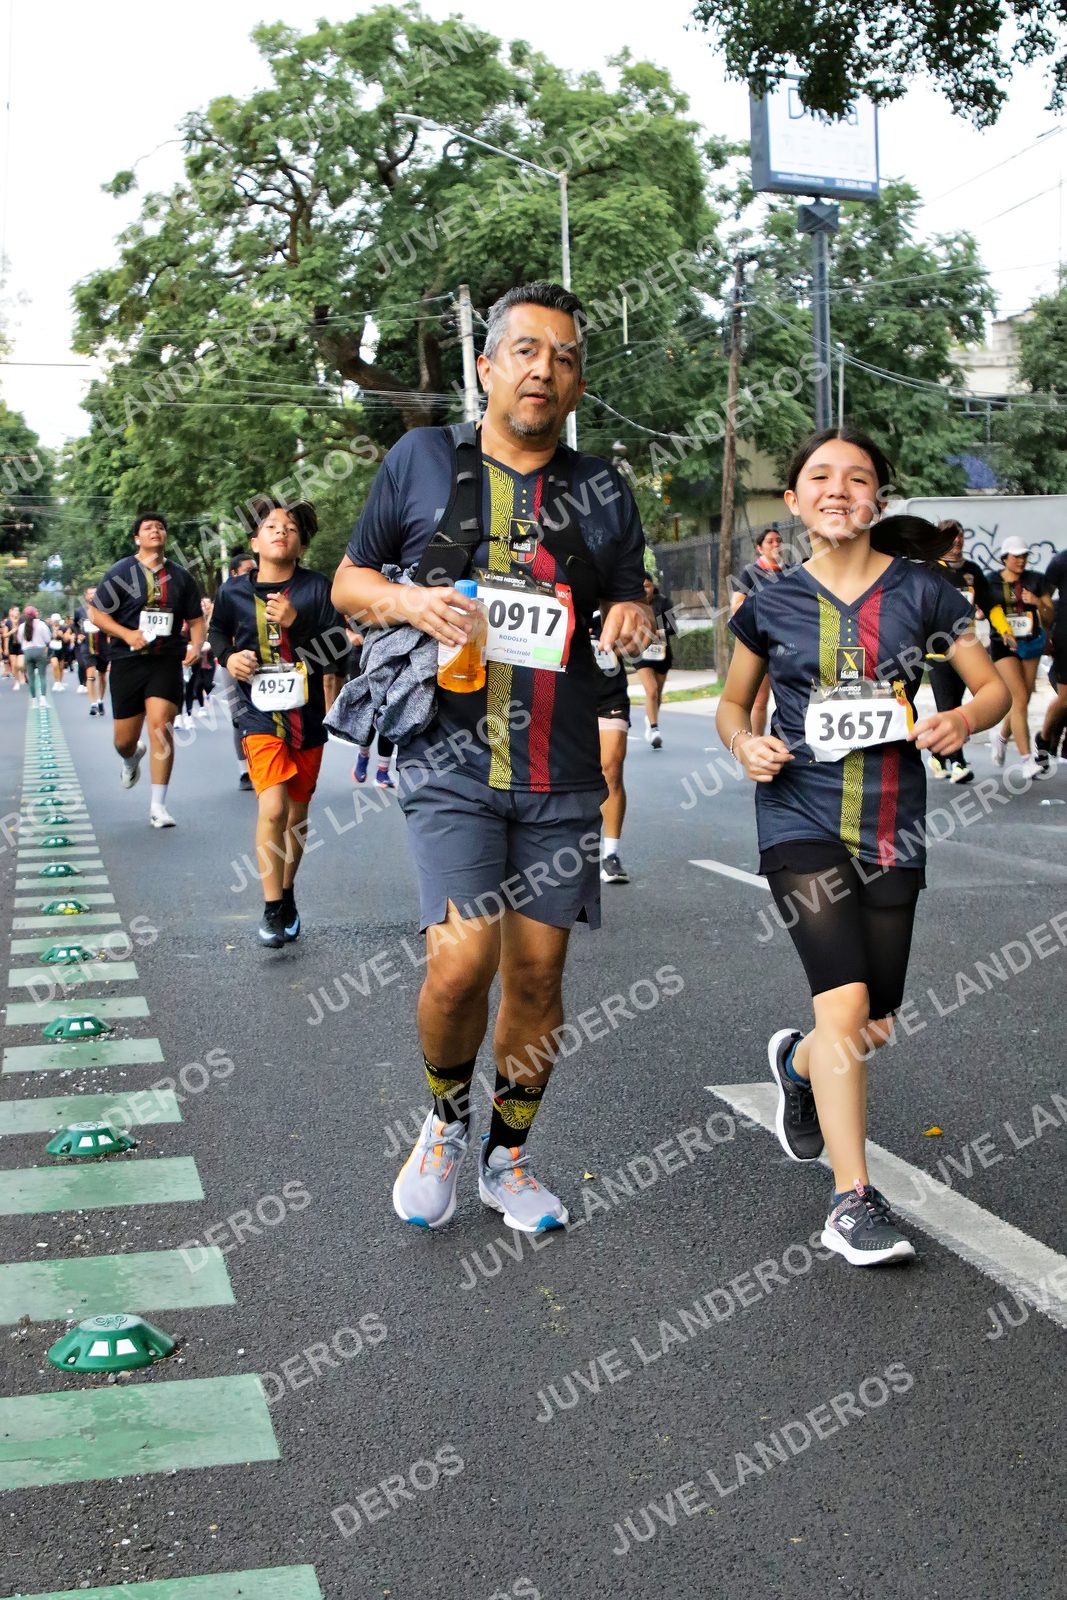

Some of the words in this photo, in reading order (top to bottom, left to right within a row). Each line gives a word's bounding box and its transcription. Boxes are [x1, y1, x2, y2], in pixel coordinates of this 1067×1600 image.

[148, 615, 168, 626] 1031
[478, 598, 562, 637] 0917
[499, 634, 528, 644] RODOLFO
[258, 678, 296, 694] 4957
[819, 710, 893, 741] 3657
